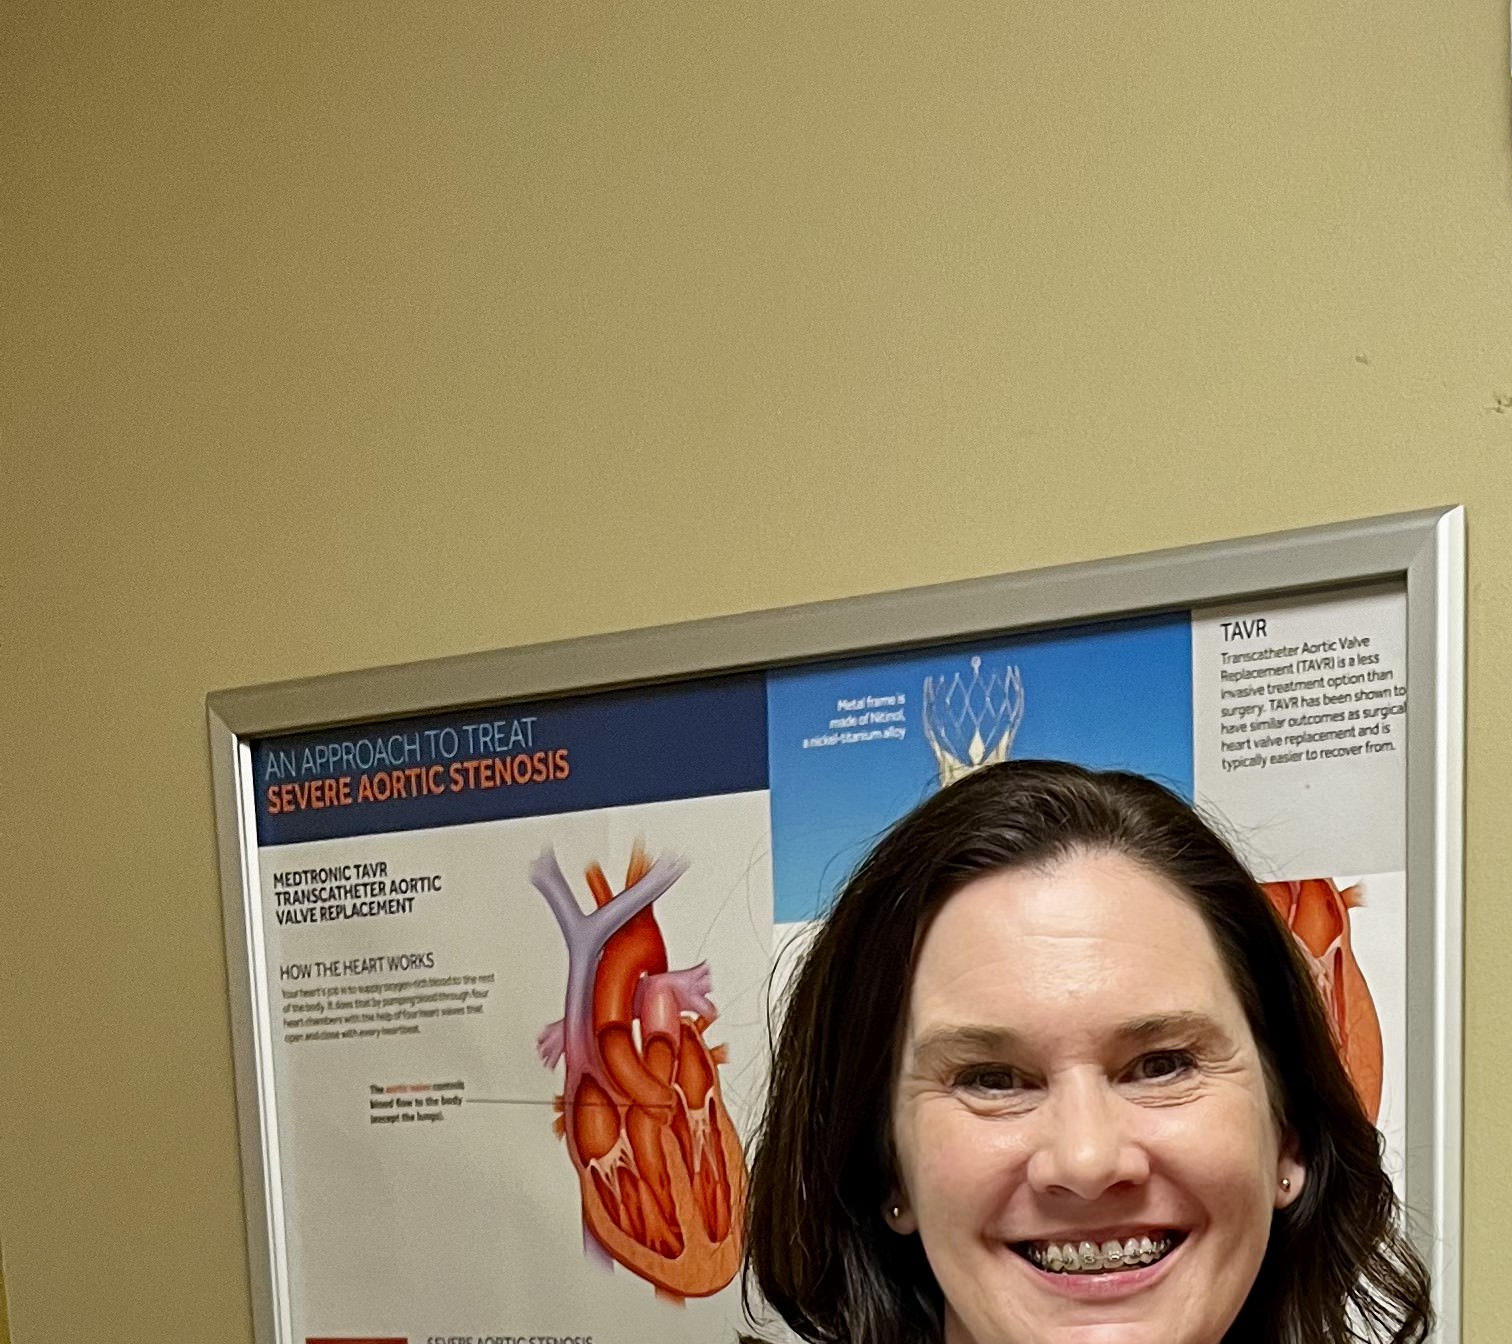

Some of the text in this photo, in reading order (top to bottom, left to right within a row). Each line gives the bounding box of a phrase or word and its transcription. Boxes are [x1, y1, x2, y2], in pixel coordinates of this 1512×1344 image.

[1220, 618, 1267, 642] TAVR
[1220, 636, 1370, 664] Transcatheter Aortic Valve
[1220, 663, 1294, 683] Replacement
[1337, 656, 1346, 669] is
[1347, 656, 1356, 667] a
[1356, 652, 1380, 666] less
[1266, 676, 1325, 695] treatment
[1326, 672, 1366, 690] option
[1366, 668, 1394, 683] than
[1268, 696, 1299, 711] TAVR
[1300, 695, 1321, 708] has
[1322, 693, 1352, 706] been
[1354, 688, 1392, 702] shown
[1393, 685, 1407, 698] to
[1220, 701, 1408, 736] have similar outcomes as surgical
[265, 717, 537, 781] AN APPROACH TO TREAT
[1220, 723, 1391, 752] heart valve replacement and is
[1221, 753, 1268, 773] typically
[1269, 749, 1304, 765] easier
[1305, 749, 1319, 761] to
[1319, 747, 1364, 760] recover
[267, 748, 570, 814] SEVERE AORTIC STENOSIS
[273, 861, 388, 889] MEDTRONIC TAVR
[274, 875, 442, 907] TRANSCATHETER AORTIC
[275, 897, 415, 925] VALVE REPLACEMENT
[280, 951, 435, 981] HOW THE HEART WORKS
